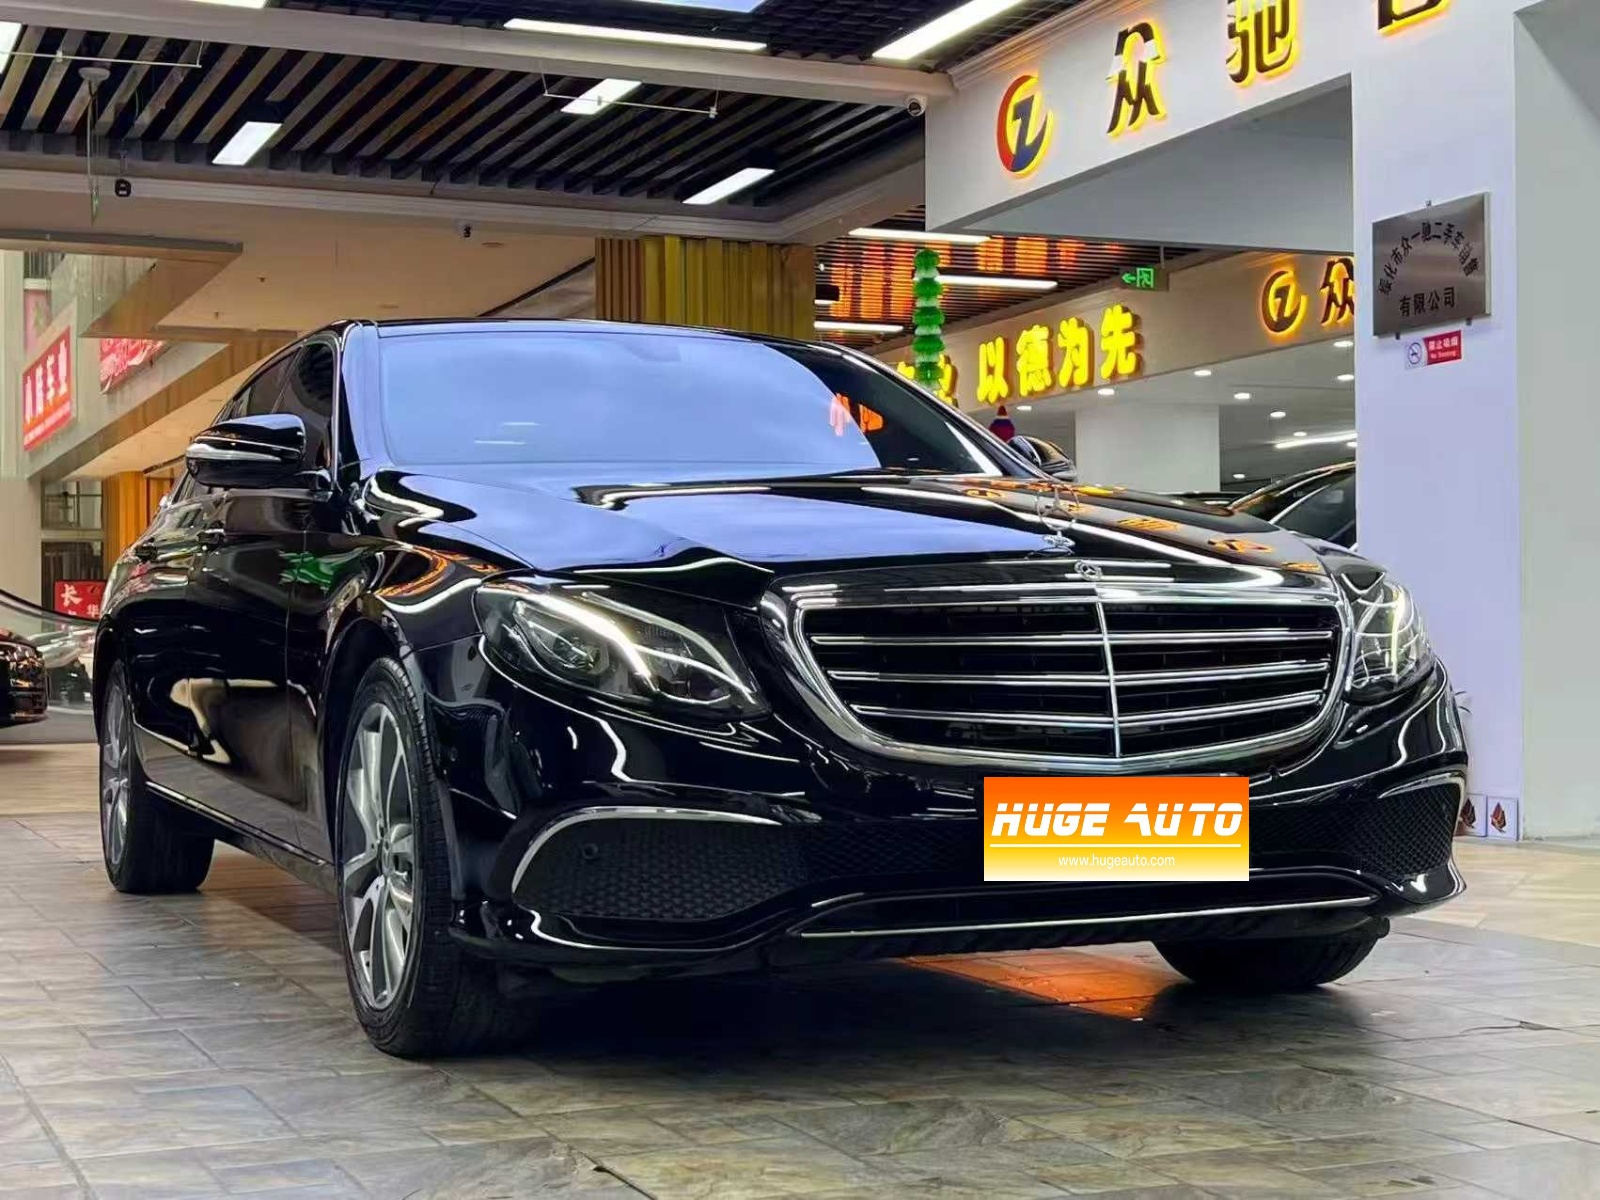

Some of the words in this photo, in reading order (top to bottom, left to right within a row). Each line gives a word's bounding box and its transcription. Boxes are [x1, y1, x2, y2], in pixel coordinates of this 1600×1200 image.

[1319, 256, 1354, 327] 众
[1399, 286, 1455, 317] 有限公司
[977, 303, 1138, 404] 以德为先
